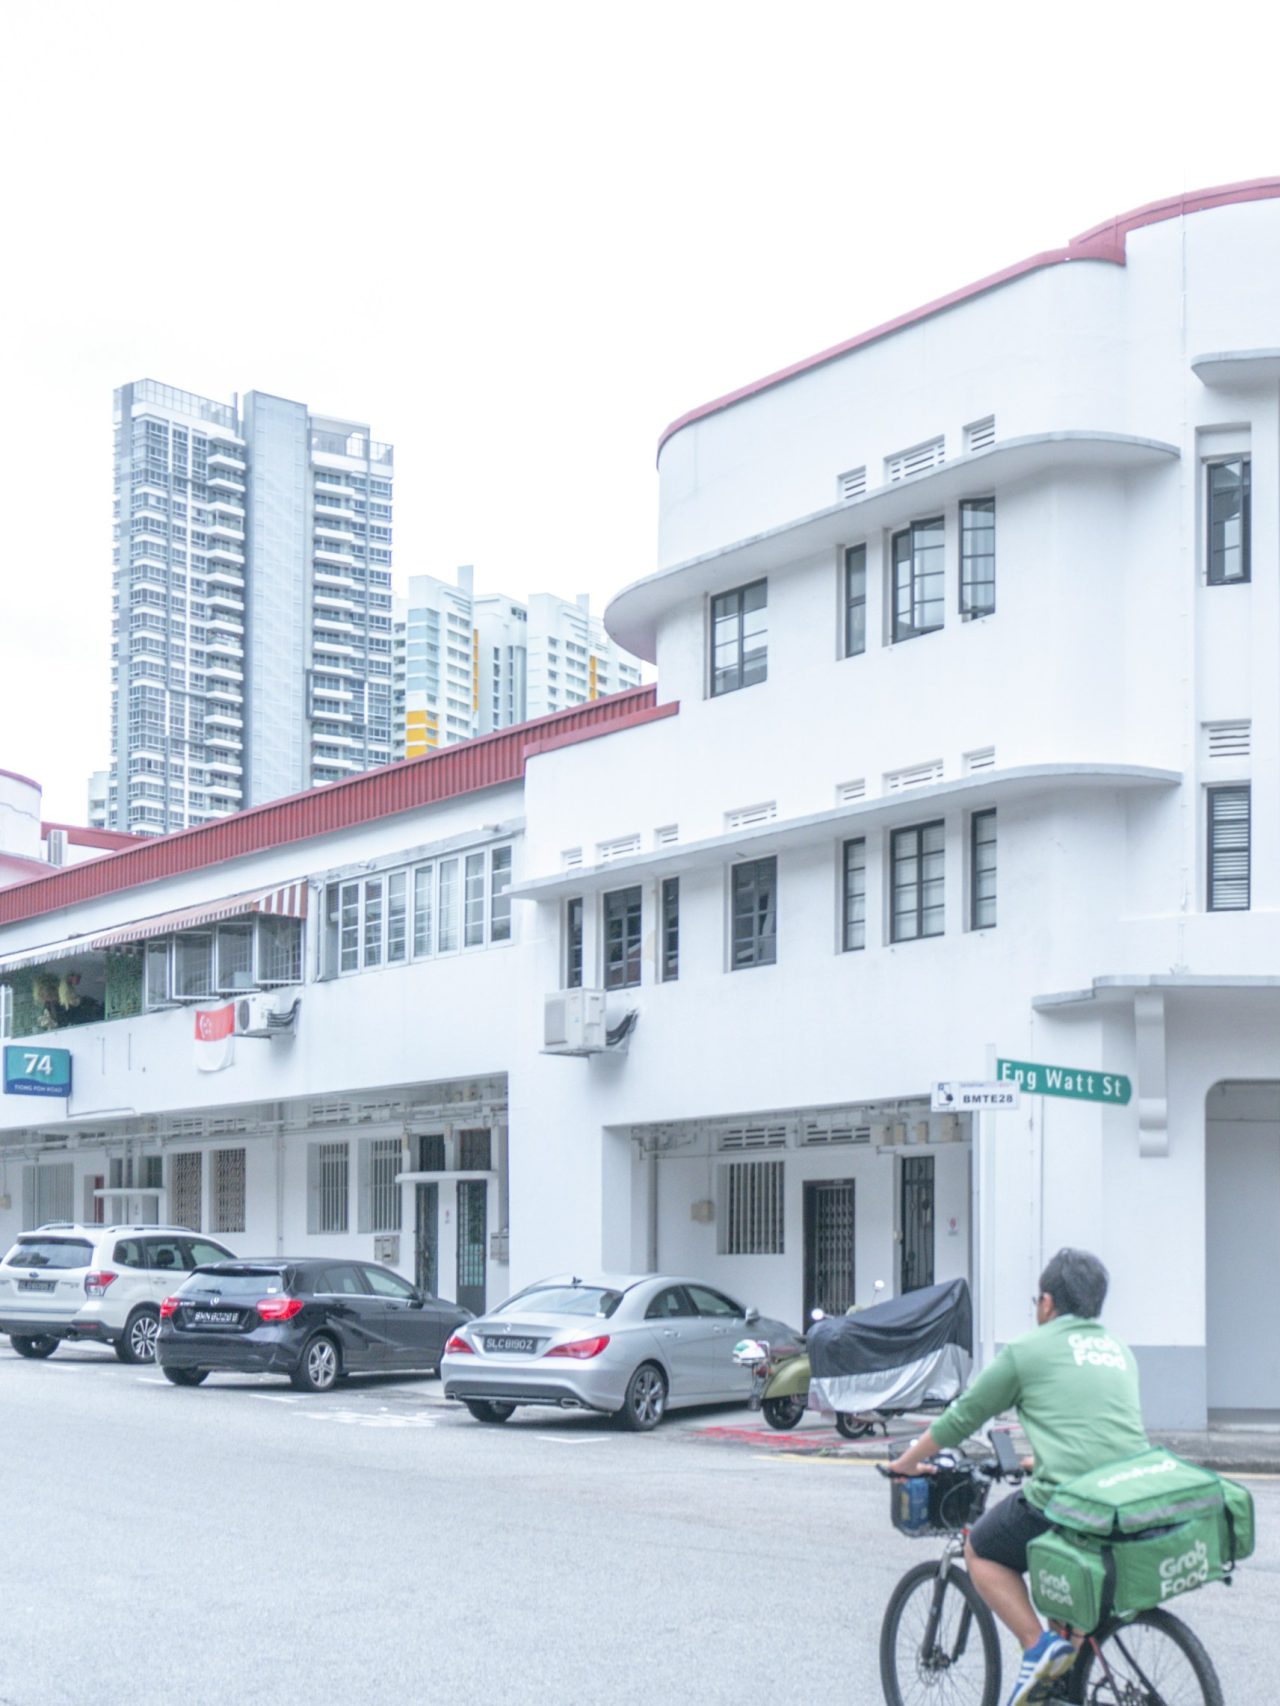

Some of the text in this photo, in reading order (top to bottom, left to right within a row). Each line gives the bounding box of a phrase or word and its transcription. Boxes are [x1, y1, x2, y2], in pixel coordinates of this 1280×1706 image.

[23, 1053, 53, 1075] 74
[1002, 1062, 1122, 1097] Eng Watt St
[963, 1094, 1014, 1104] BMTE28
[1068, 1333, 1119, 1352] Grab
[1073, 1347, 1127, 1371] Food
[1159, 1539, 1207, 1579] Grab
[1039, 1570, 1071, 1593] Grab
[1161, 1557, 1209, 1599] Food
[1040, 1584, 1073, 1606] Food
